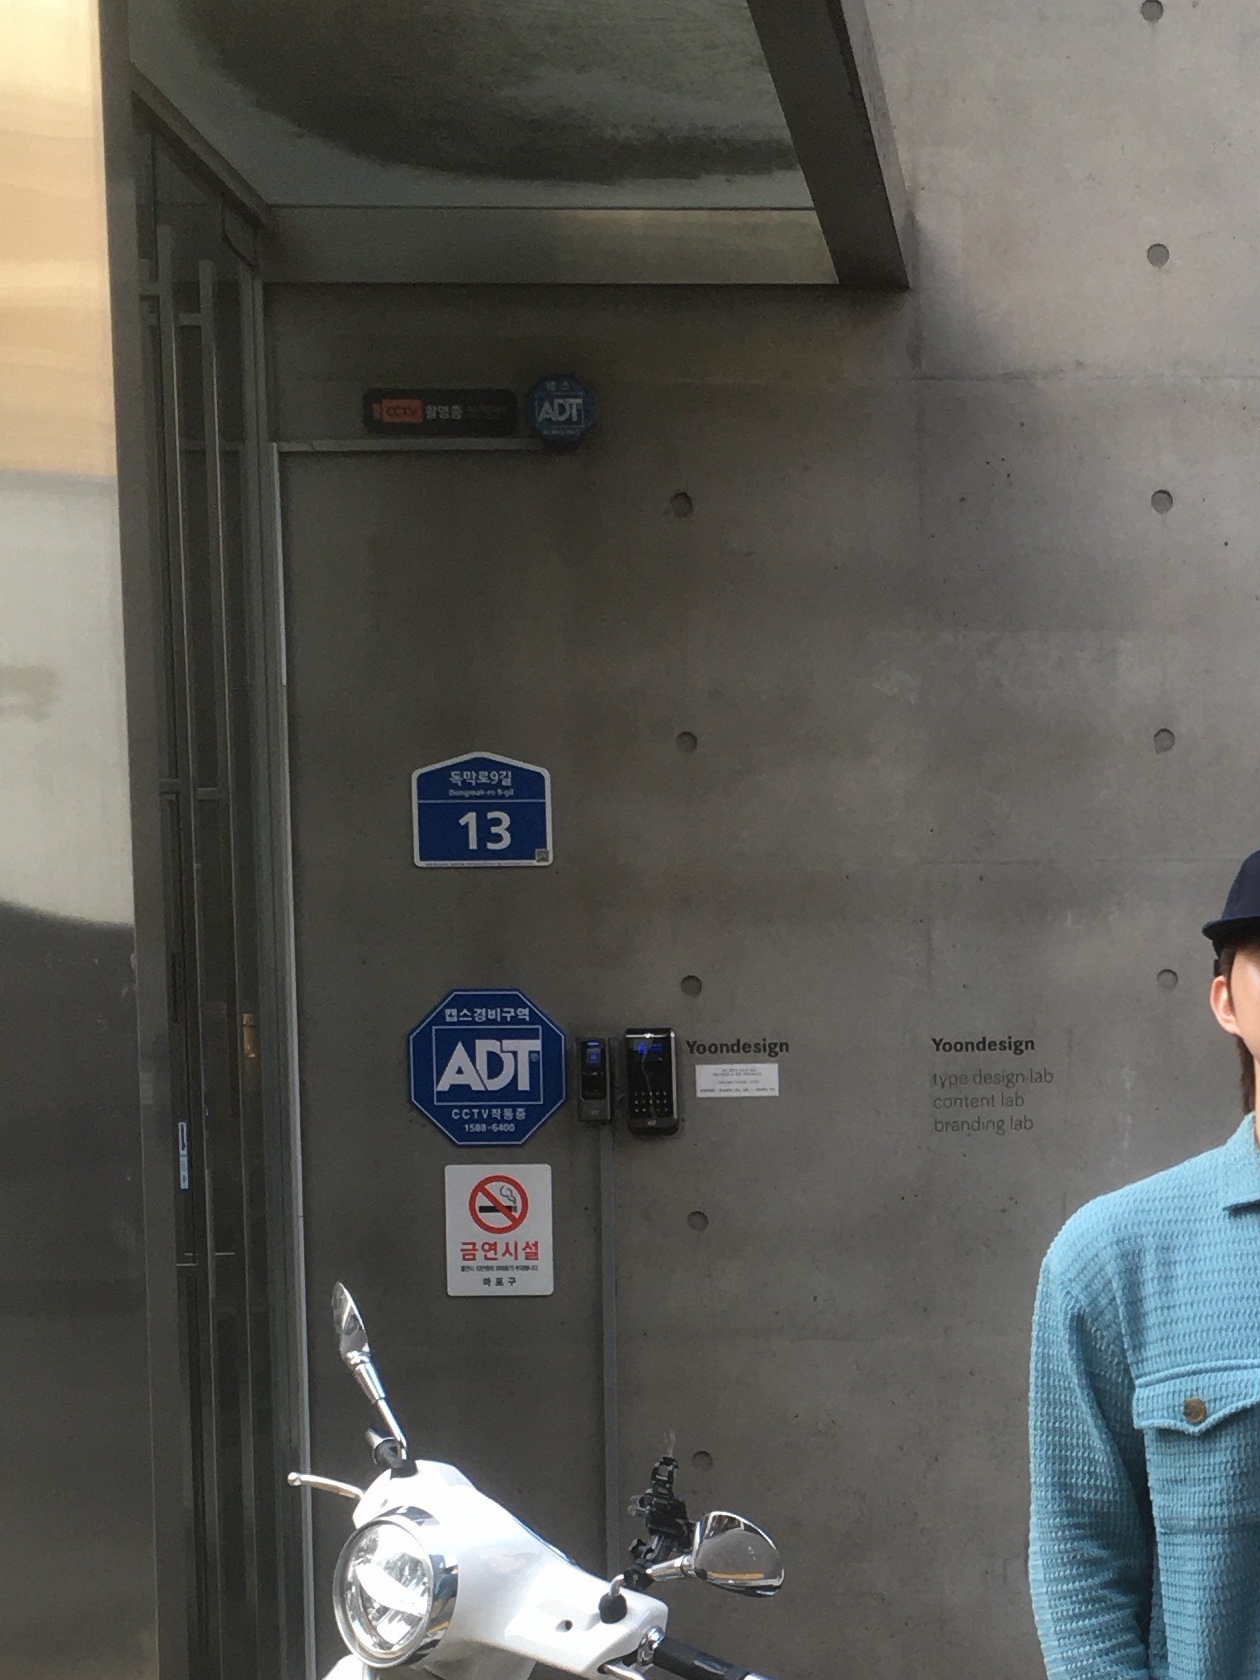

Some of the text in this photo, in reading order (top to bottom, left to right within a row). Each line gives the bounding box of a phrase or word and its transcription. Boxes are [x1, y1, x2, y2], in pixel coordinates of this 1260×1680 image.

[537, 398, 583, 422] ADT
[449, 770, 512, 786] 독막로9길
[458, 810, 512, 850] 13
[444, 1007, 530, 1022] 캡스경비구역
[686, 1038, 790, 1058] Yoondesign
[931, 1036, 1035, 1055] Yoondesign
[436, 1038, 541, 1092] ADT
[932, 1068, 1054, 1089] type design lab
[933, 1092, 1025, 1109] content lab
[934, 1115, 1034, 1135] branding lab
[460, 1240, 539, 1262] 금연시설
